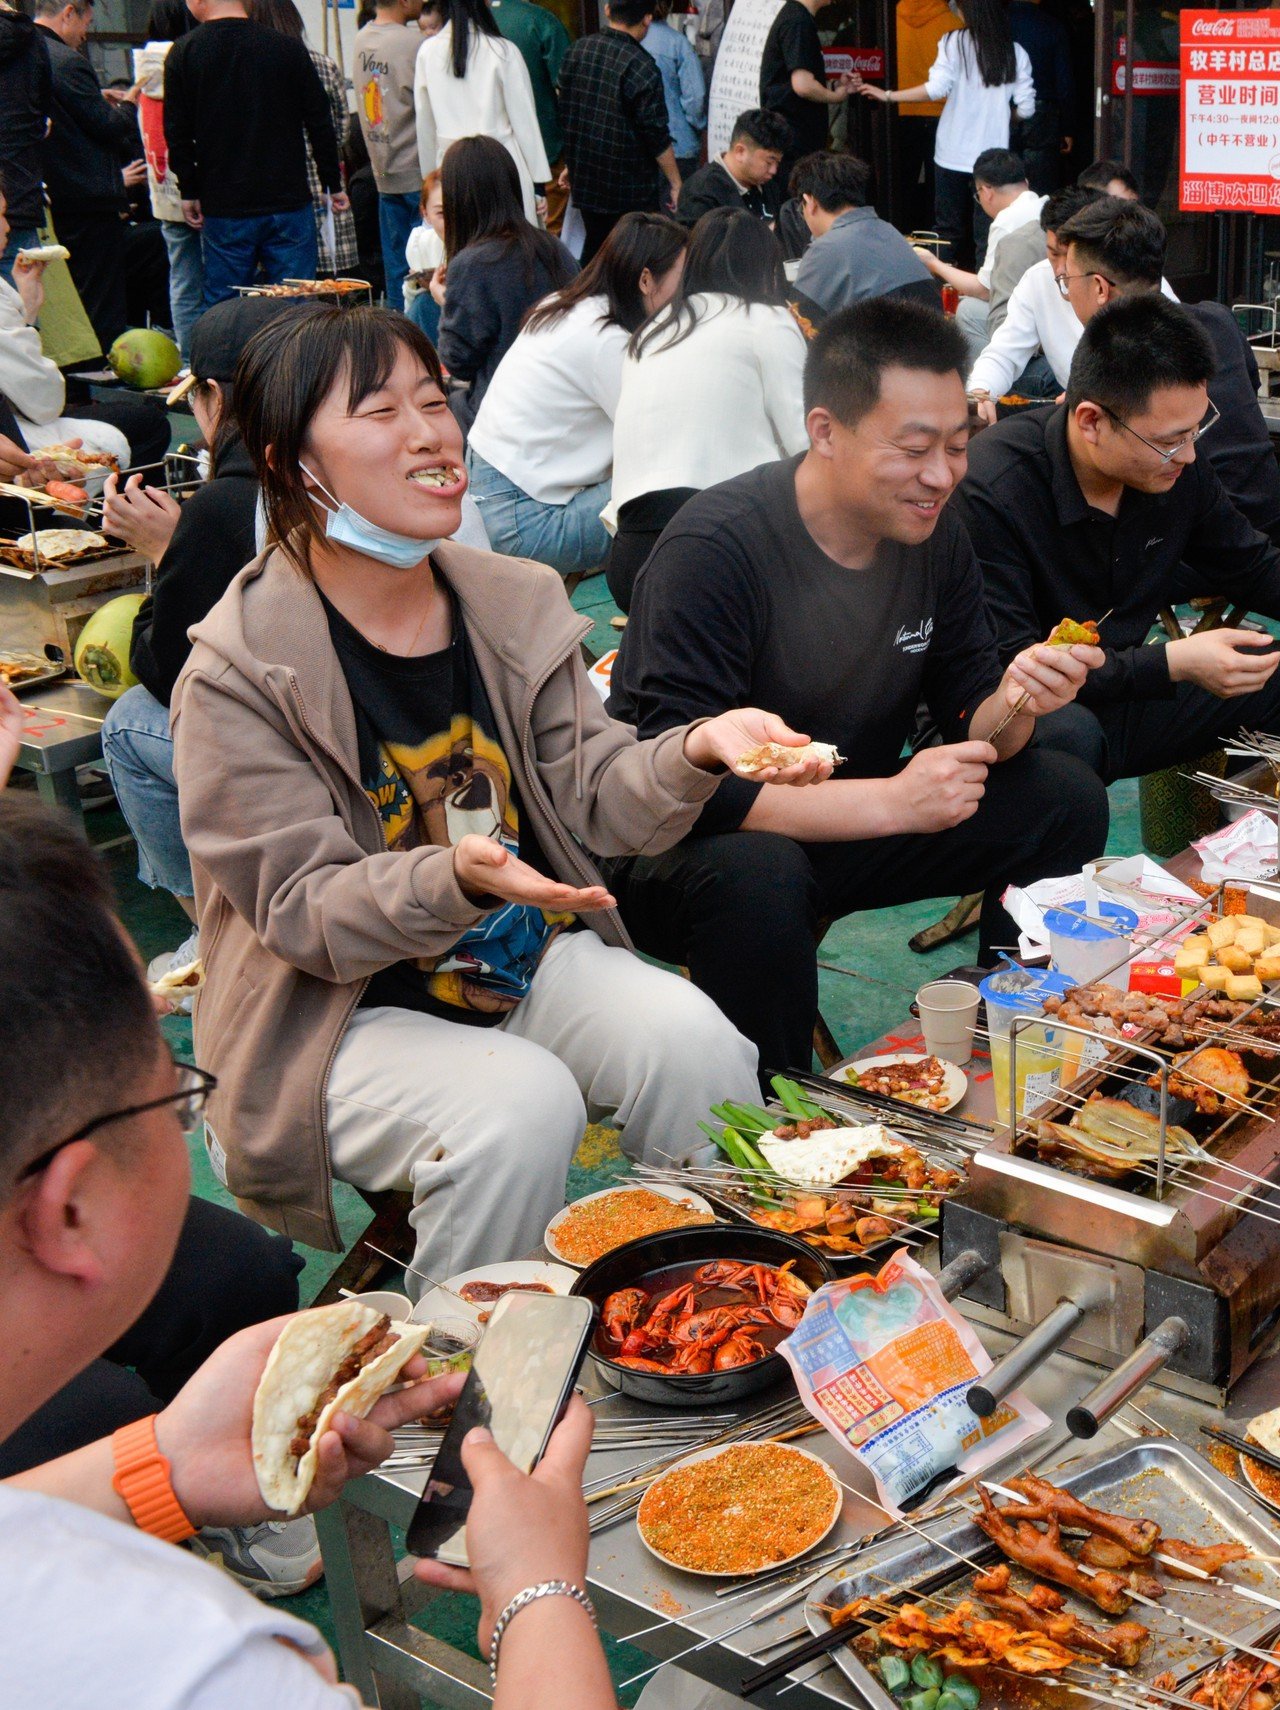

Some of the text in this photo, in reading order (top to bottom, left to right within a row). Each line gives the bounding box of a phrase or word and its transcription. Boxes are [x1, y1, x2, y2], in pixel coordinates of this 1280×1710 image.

[358, 51, 389, 75] Vans
[1198, 84, 1279, 106] 营业时间
